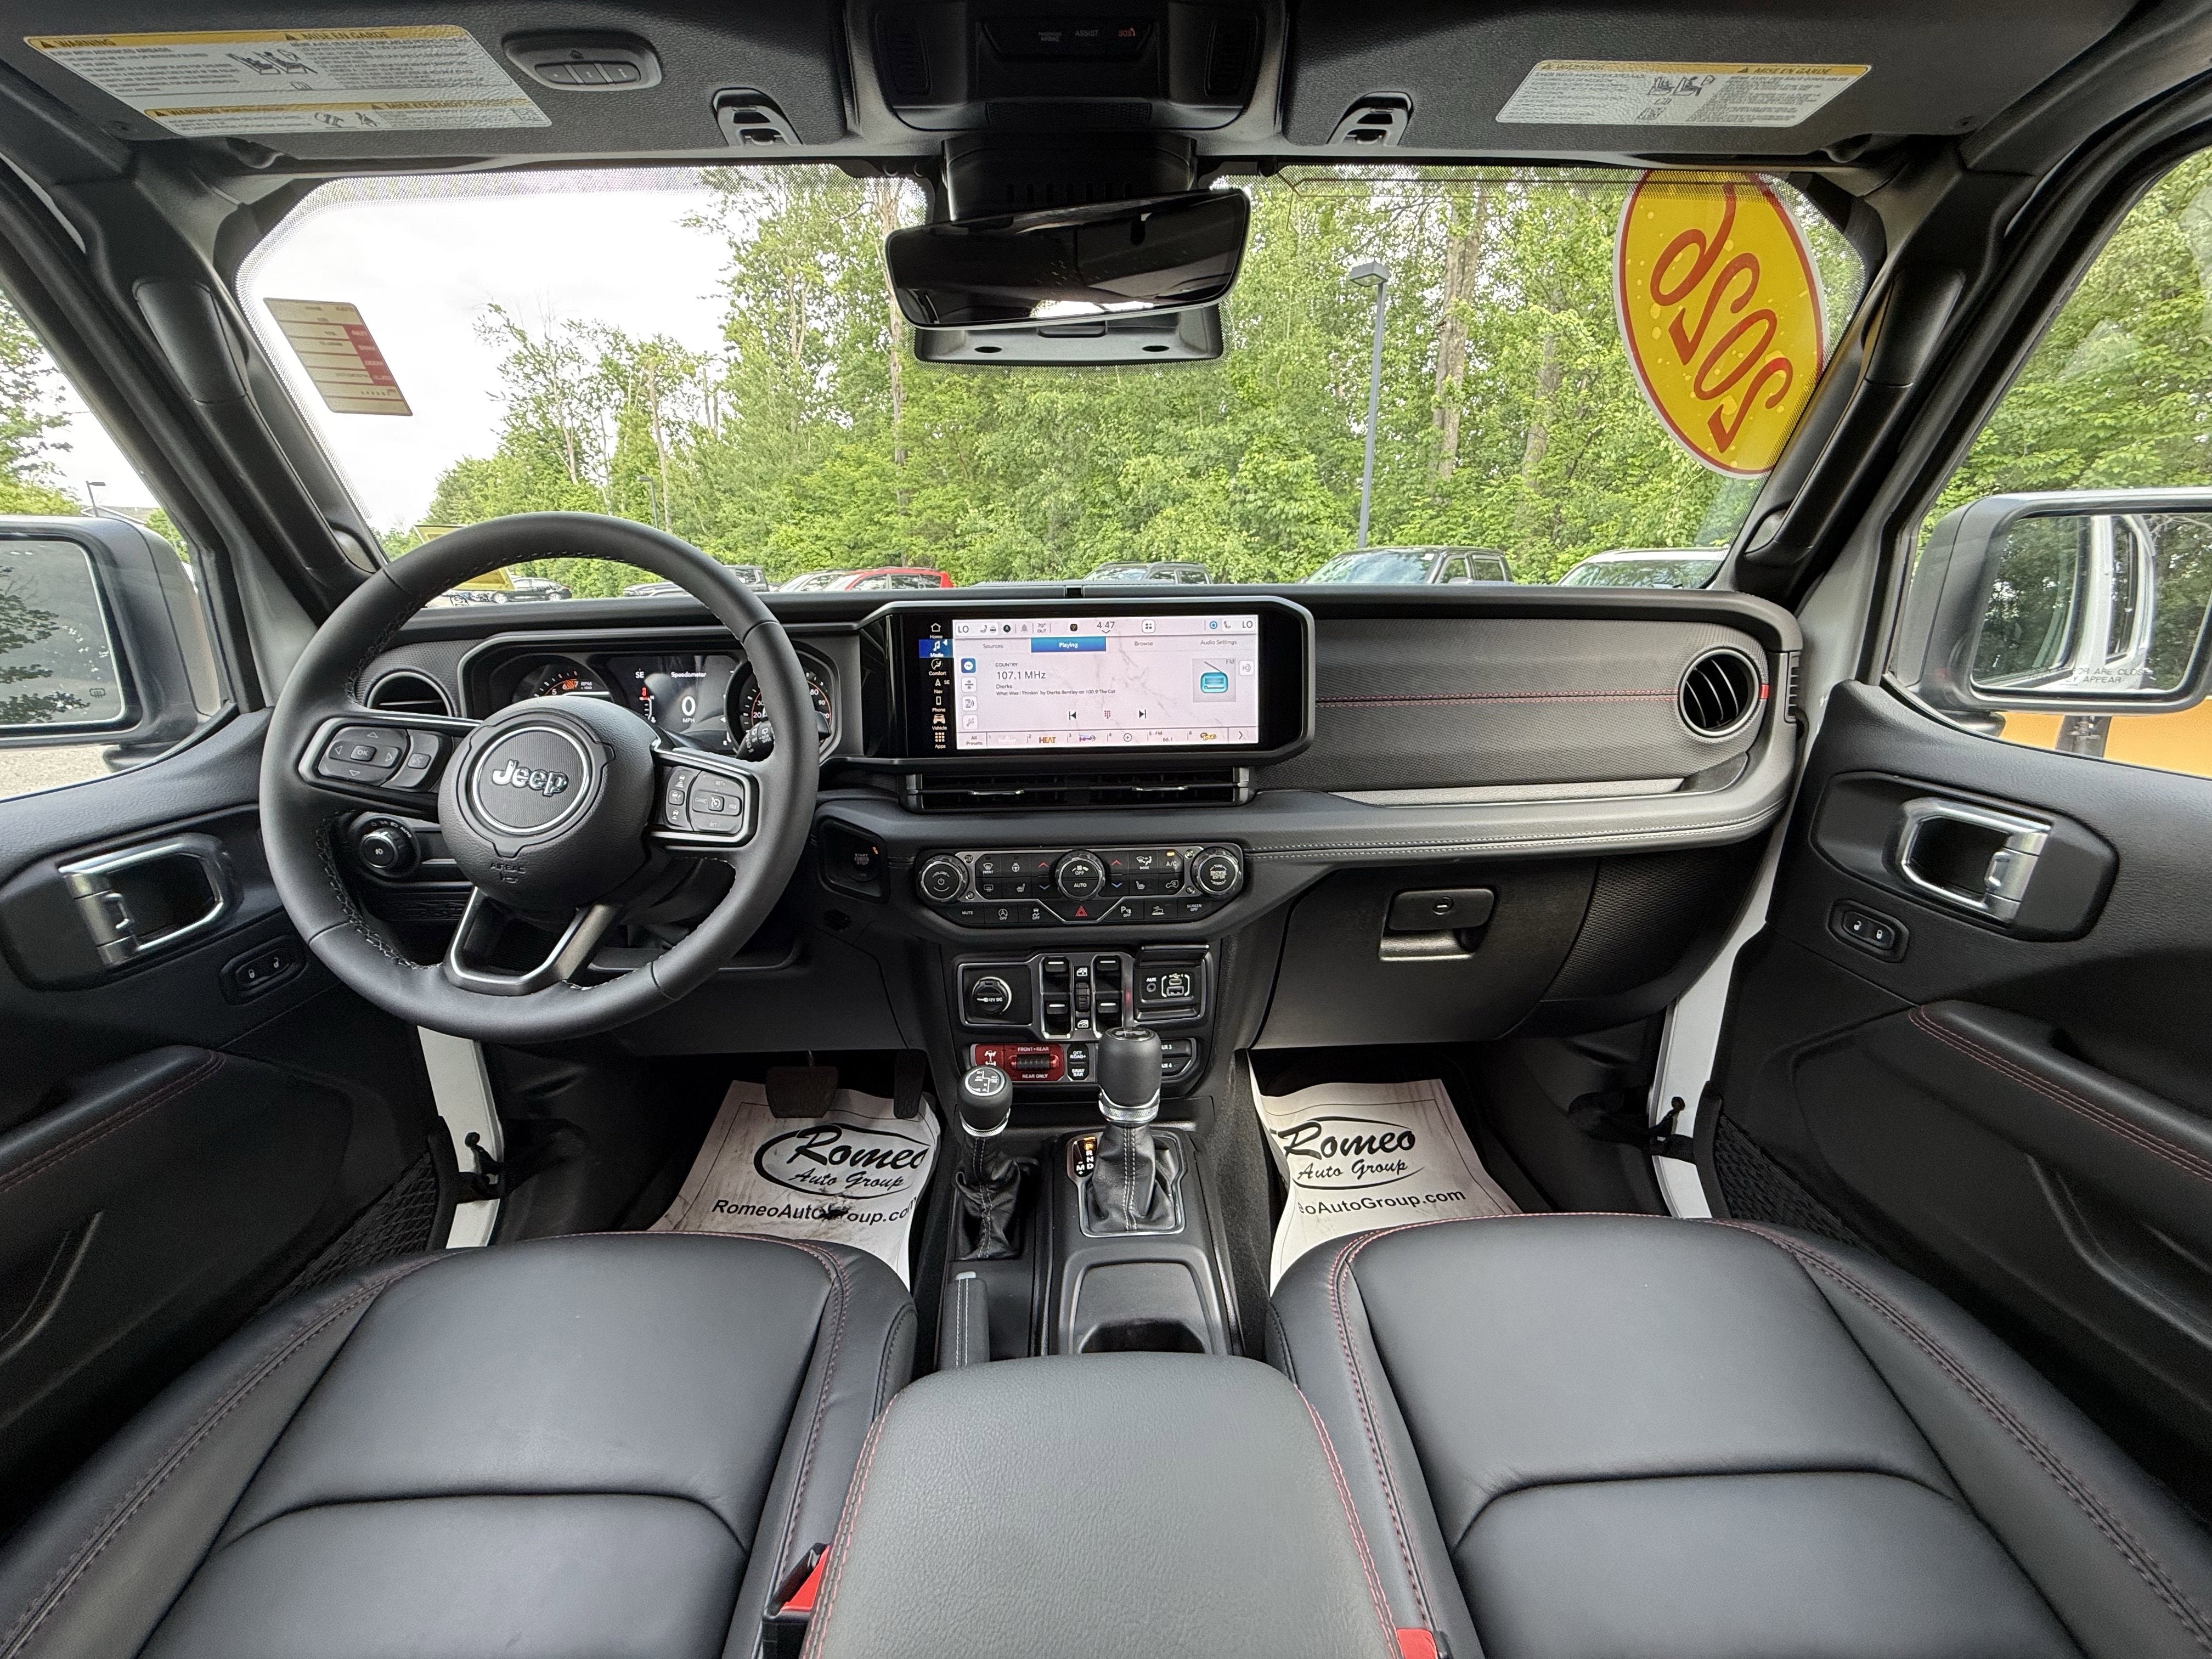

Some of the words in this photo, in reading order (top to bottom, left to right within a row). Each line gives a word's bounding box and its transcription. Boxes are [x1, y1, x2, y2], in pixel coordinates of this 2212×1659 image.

[54, 39, 116, 48] WARNING
[332, 31, 349, 40] EN
[997, 671, 1022, 679] 107.1
[1025, 670, 1046, 679] MHz
[681, 696, 696, 716] 0
[492, 759, 569, 797] Jeep
[786, 1124, 930, 1170] Romeo
[1277, 1121, 1415, 1160] Romeo
[788, 1167, 837, 1186] Auto
[844, 1170, 905, 1190] Group
[1297, 1162, 1343, 1180] Auto
[1351, 1159, 1408, 1180] Group
